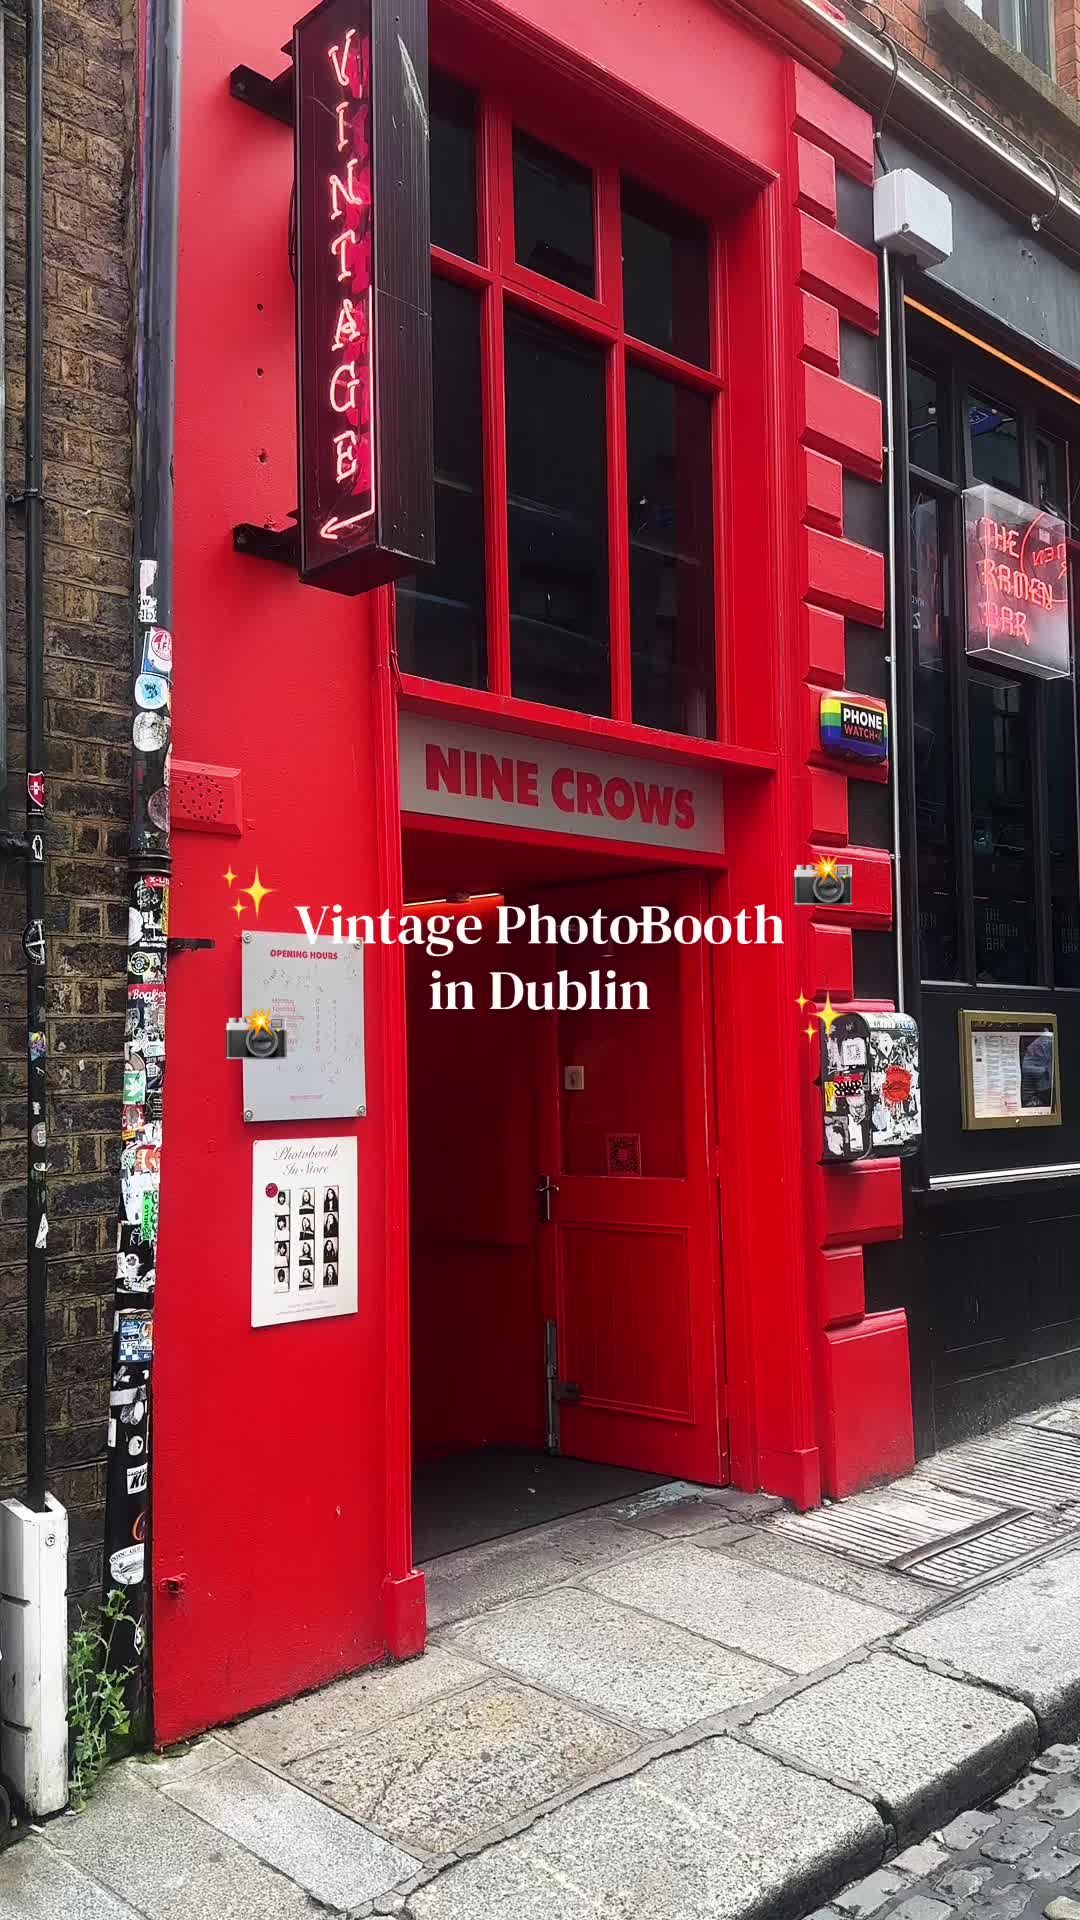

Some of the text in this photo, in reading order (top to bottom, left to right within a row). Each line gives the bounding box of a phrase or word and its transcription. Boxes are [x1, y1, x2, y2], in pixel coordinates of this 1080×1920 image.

[328, 29, 362, 484] VINTAGE
[978, 514, 1020, 558] THE
[981, 558, 1054, 611] RAMEN
[979, 602, 1031, 647] BAR
[843, 707, 883, 730] PHONE
[844, 723, 875, 741] WATCH
[425, 743, 696, 830] NINE CROWS
[270, 949, 339, 960] OPENING HOURS
[273, 1144, 340, 1161] Photobooth
[282, 1161, 330, 1176] In Store
